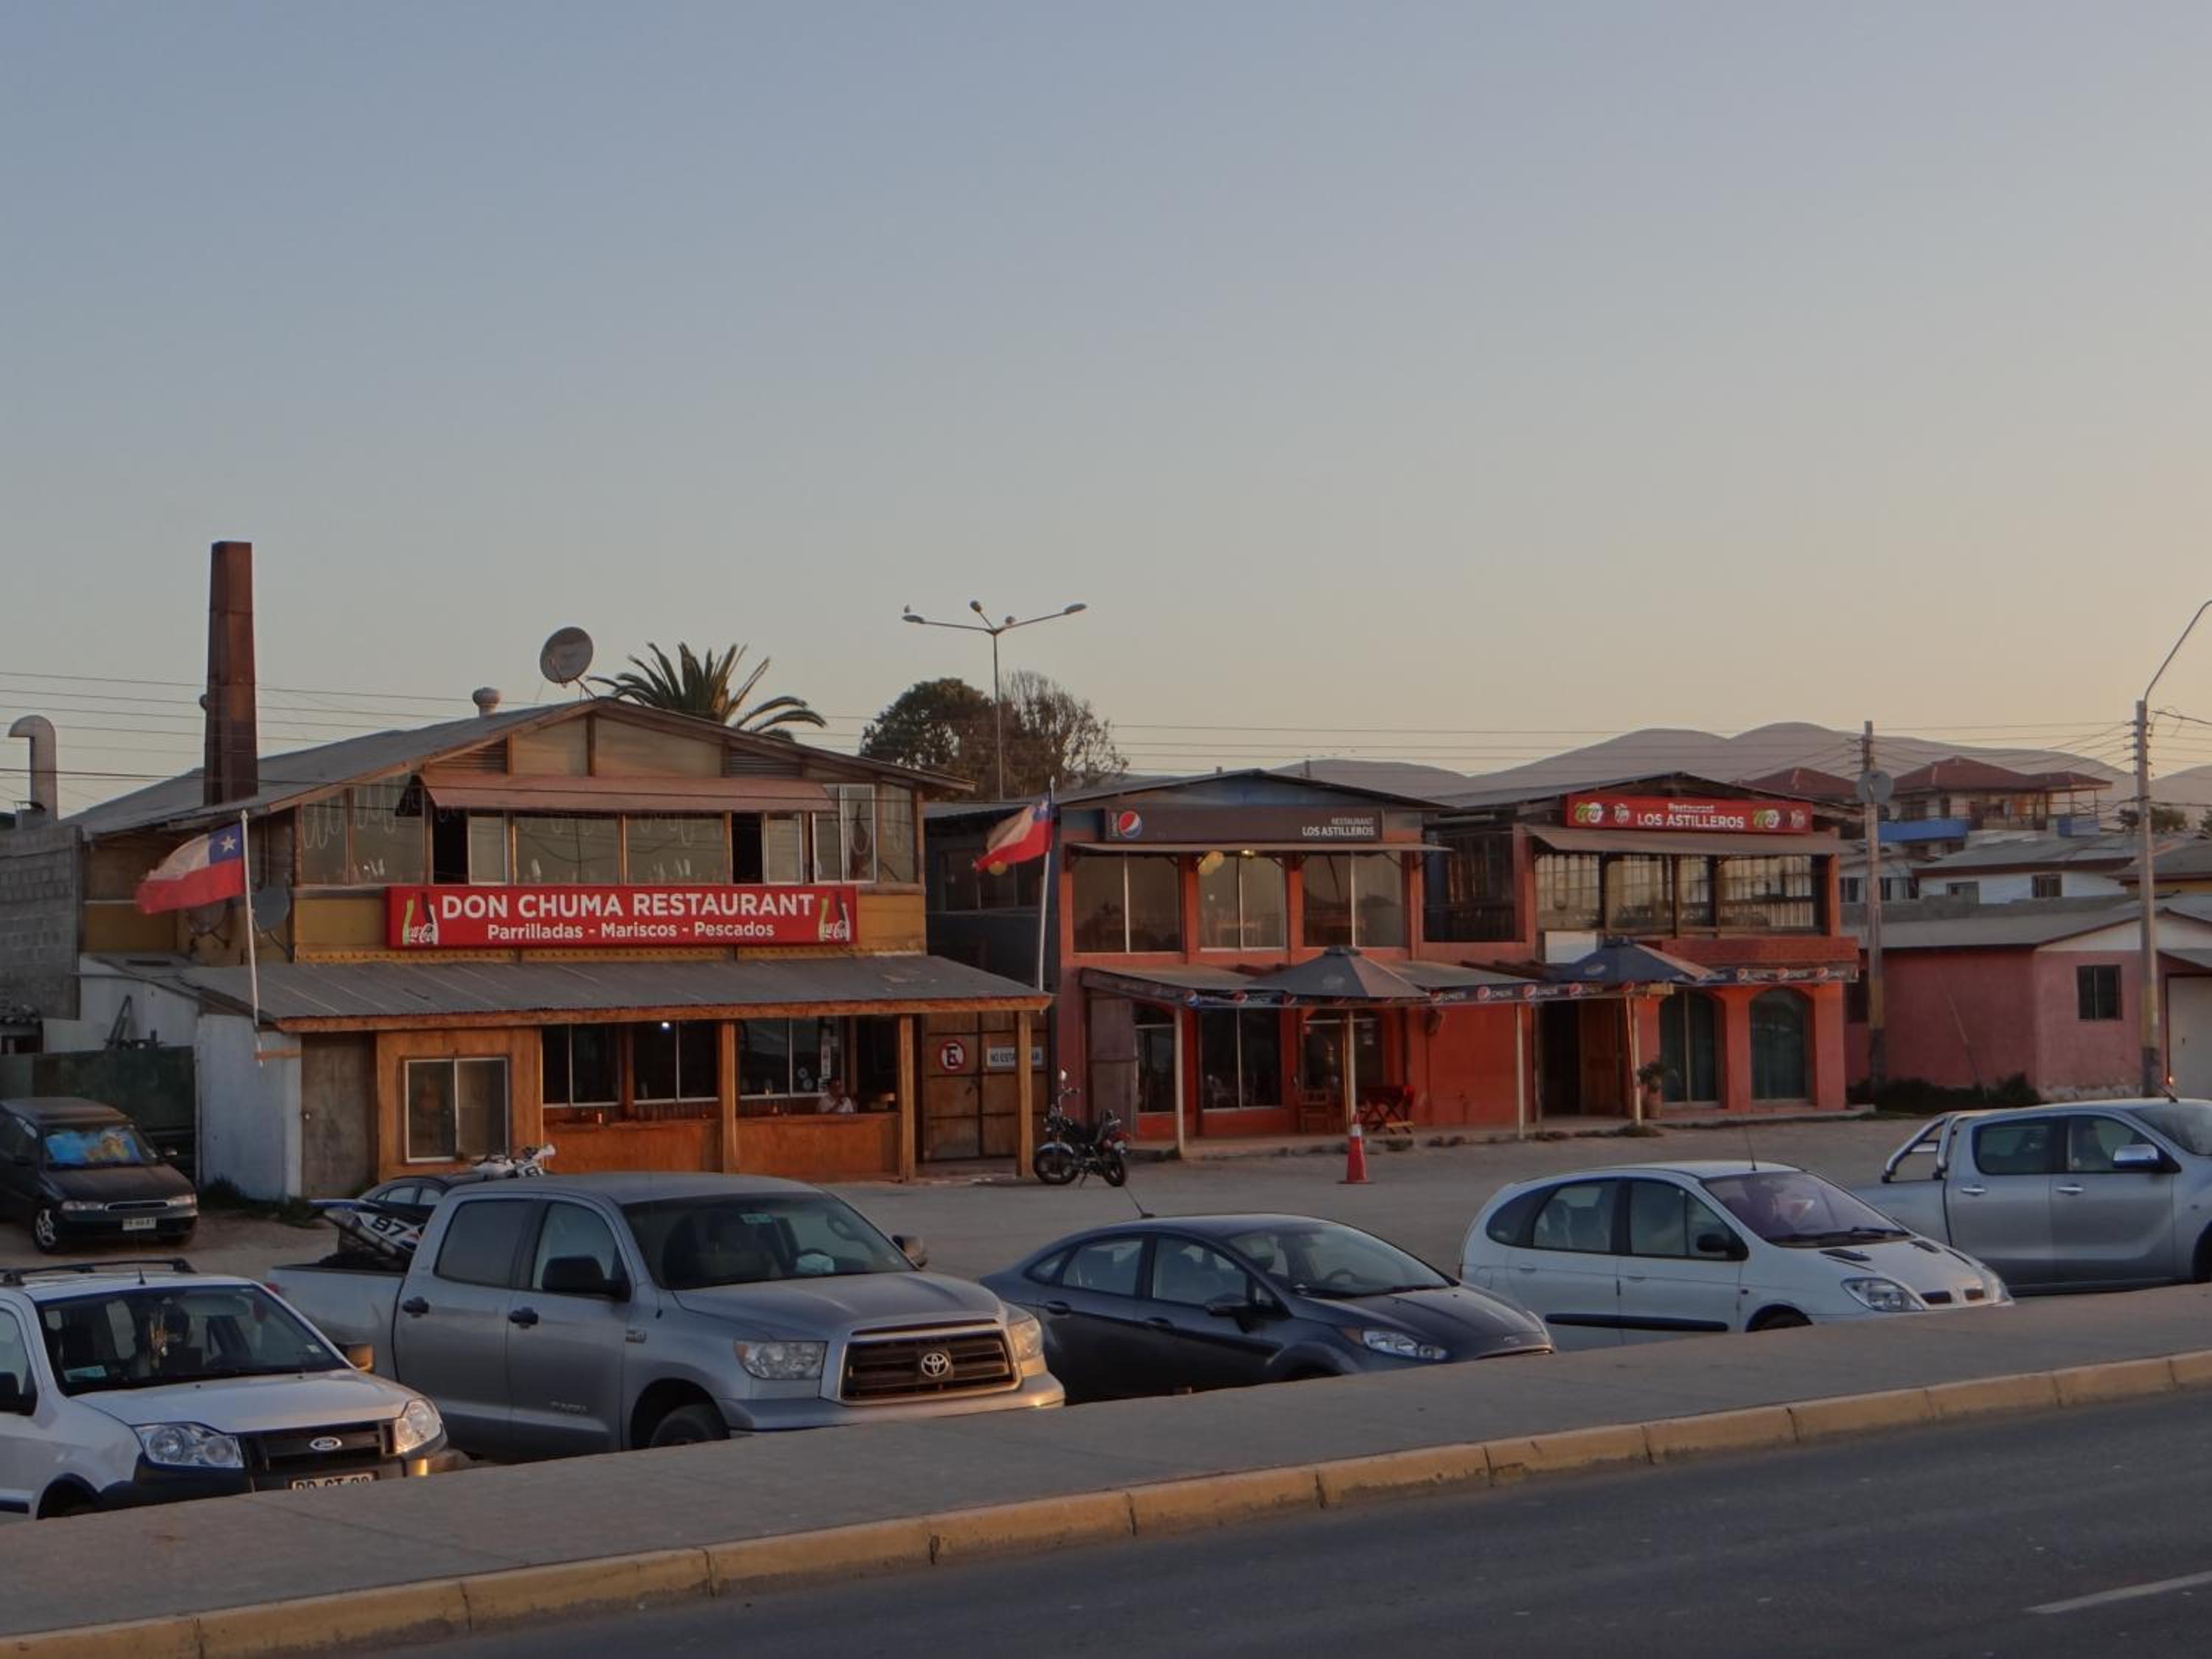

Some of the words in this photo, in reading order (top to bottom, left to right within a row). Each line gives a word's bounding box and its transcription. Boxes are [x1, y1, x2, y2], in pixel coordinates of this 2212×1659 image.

[1636, 813, 1663, 827] LOS
[1666, 813, 1745, 828] ASTILLEROS
[1301, 826, 1321, 836] LOS
[1321, 826, 1375, 836] ASTILLEROS
[441, 894, 509, 919] DON
[518, 893, 625, 919] CHUMA
[632, 892, 815, 917] RESTAURANT
[487, 923, 583, 940] Parrilladas
[600, 922, 678, 939] Mariscos
[693, 921, 776, 937] Pescados
